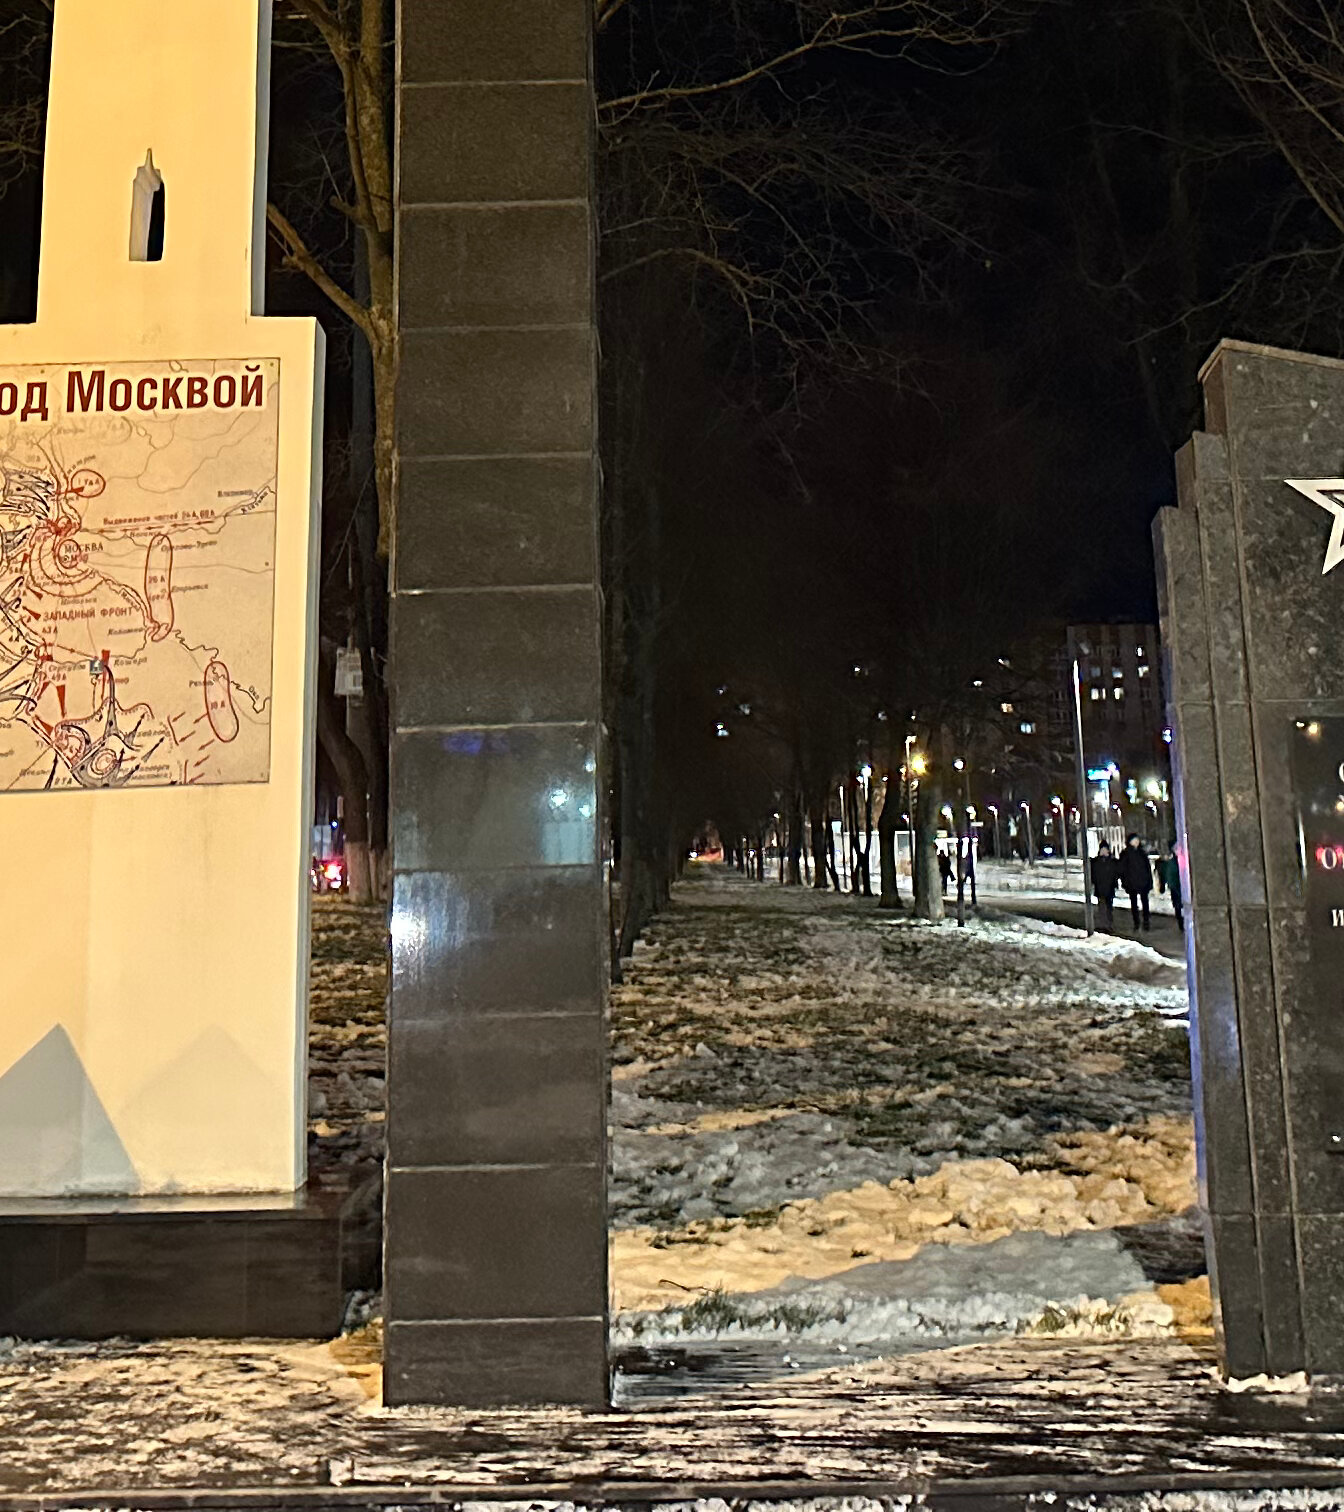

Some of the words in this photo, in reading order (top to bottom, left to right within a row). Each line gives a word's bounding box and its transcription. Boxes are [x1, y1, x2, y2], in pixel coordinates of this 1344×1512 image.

[66, 365, 264, 413] Москвой
[64, 542, 104, 554] МОСКВА
[43, 609, 96, 622] ЗАПАДНЫЙ
[100, 606, 133, 618] ФРОНТ
